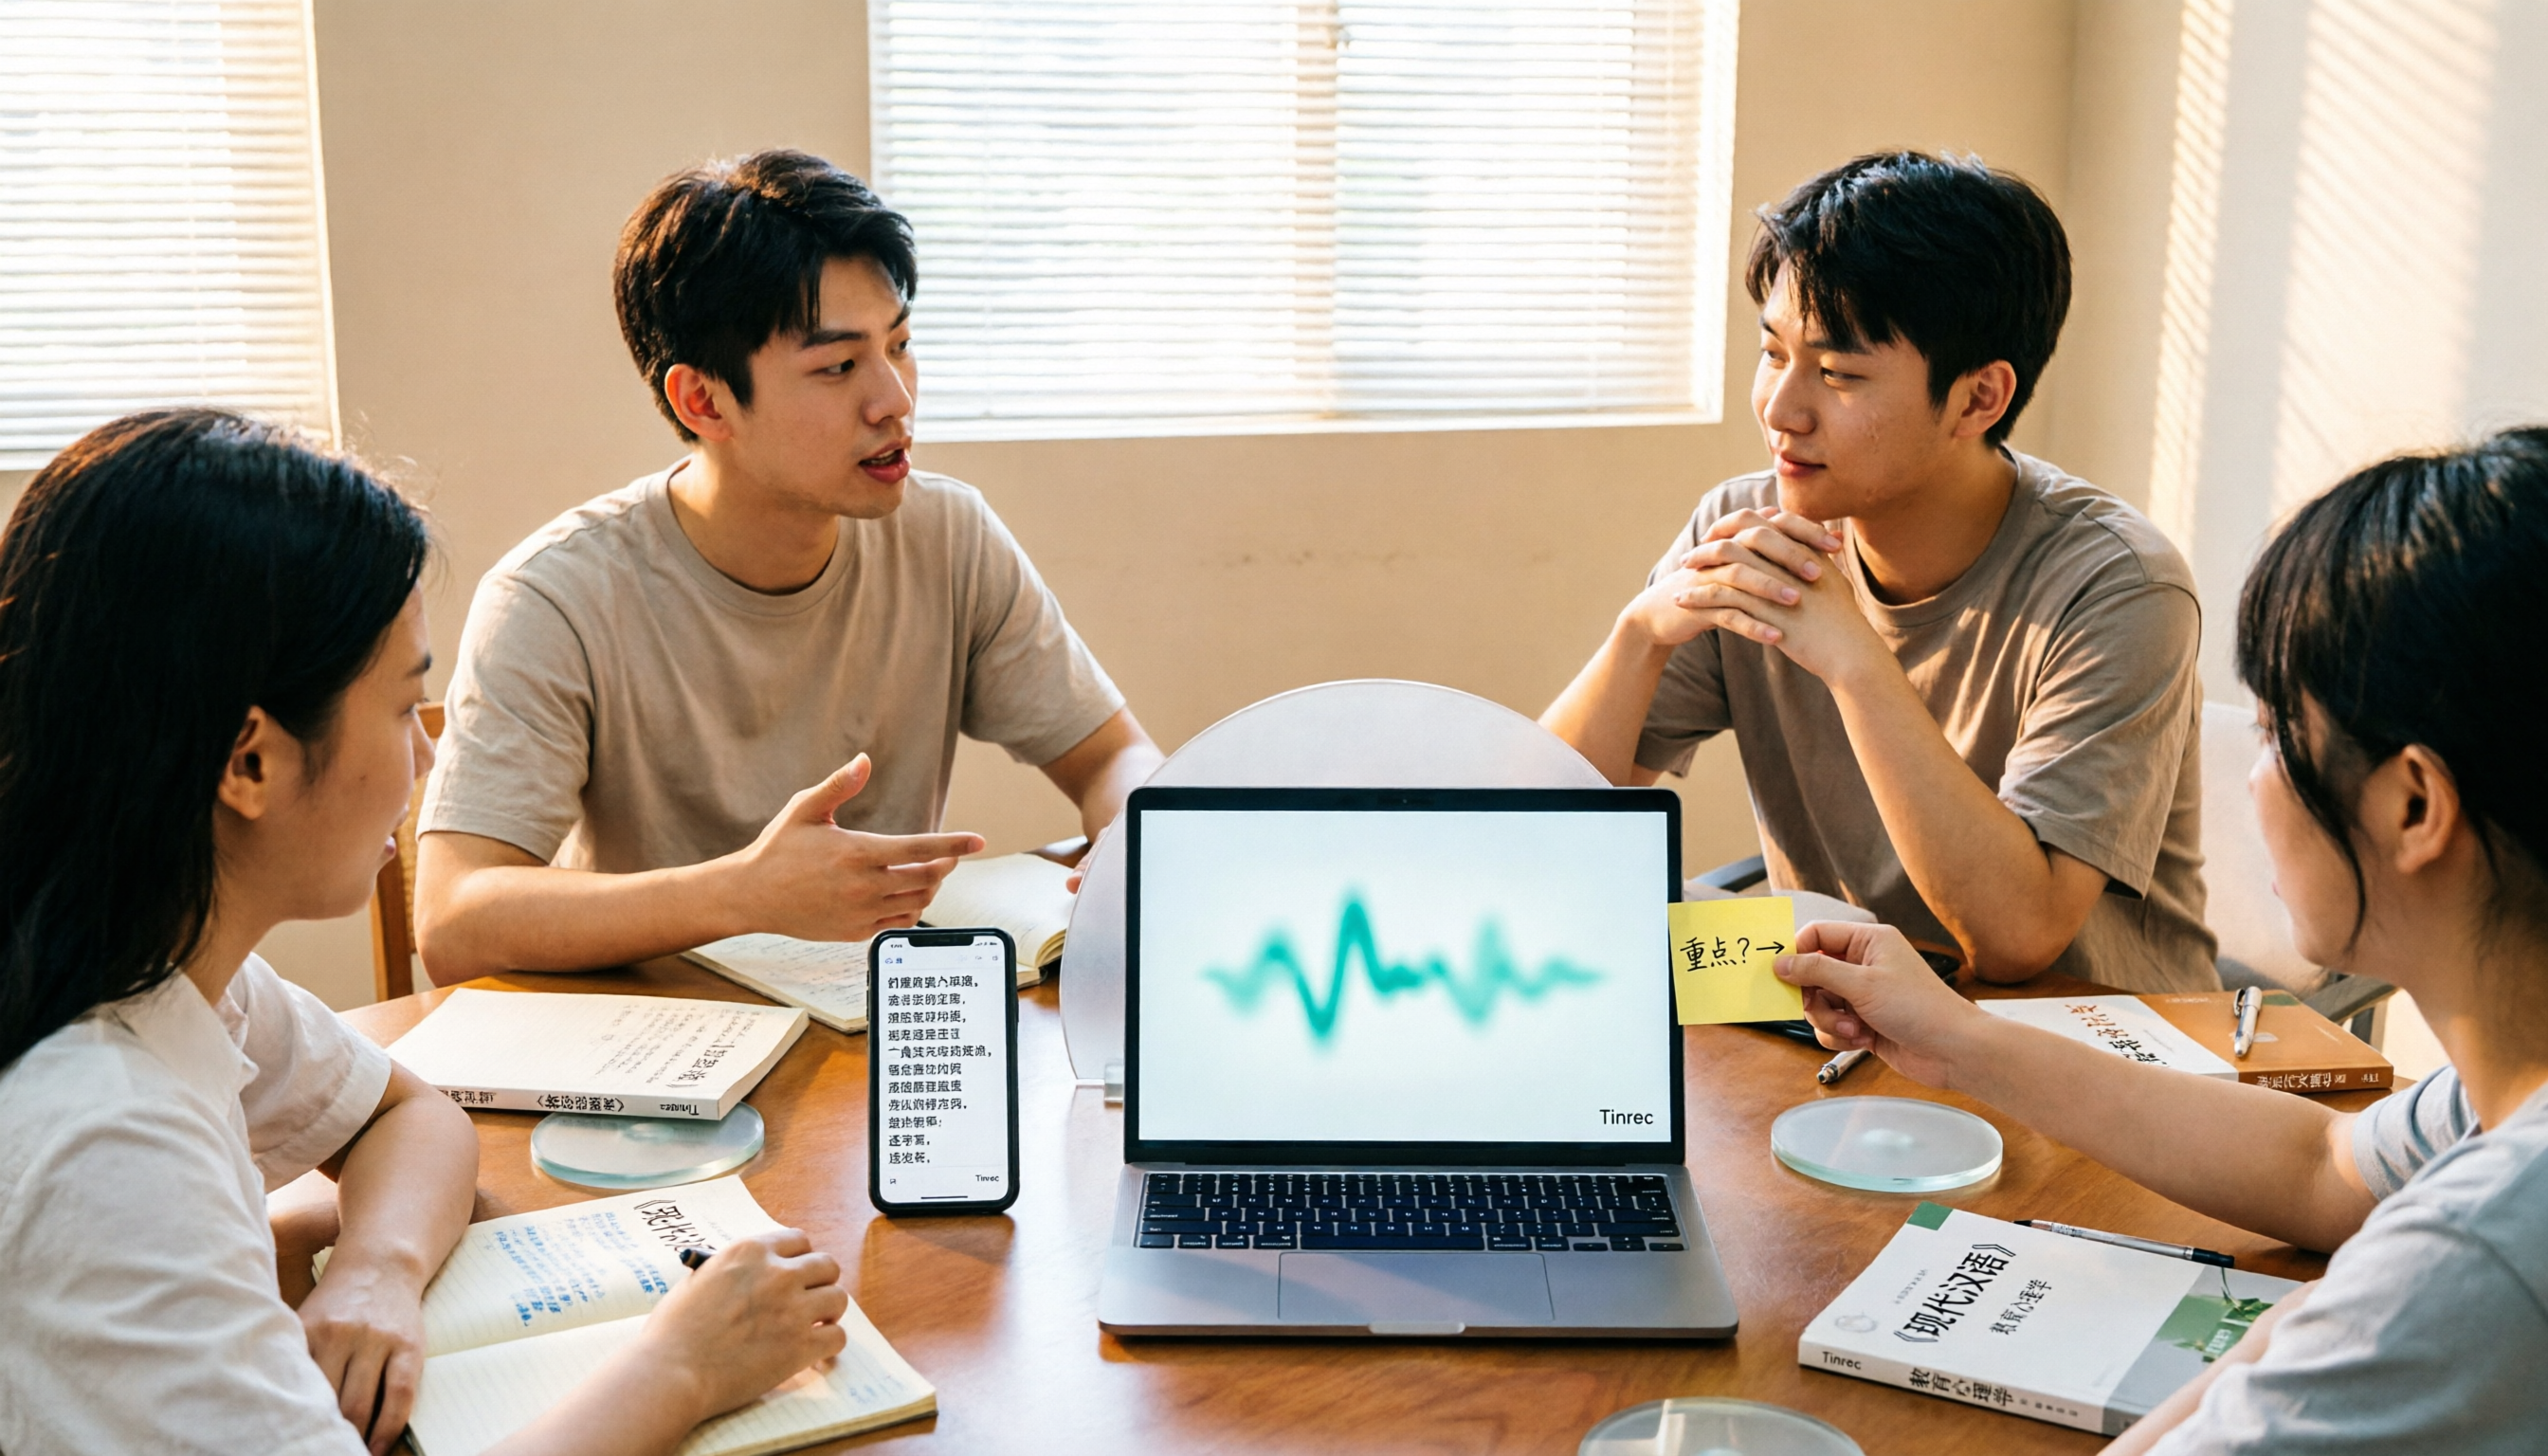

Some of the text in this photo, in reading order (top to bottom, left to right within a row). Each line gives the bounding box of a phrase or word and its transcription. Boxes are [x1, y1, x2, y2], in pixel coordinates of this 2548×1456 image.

[1680, 937, 1750, 972] 重点?
[1599, 1109, 1654, 1125] Tinrec
[1894, 1244, 2016, 1342] 《现代汉语》
[1822, 1351, 1862, 1371] Tinrec
